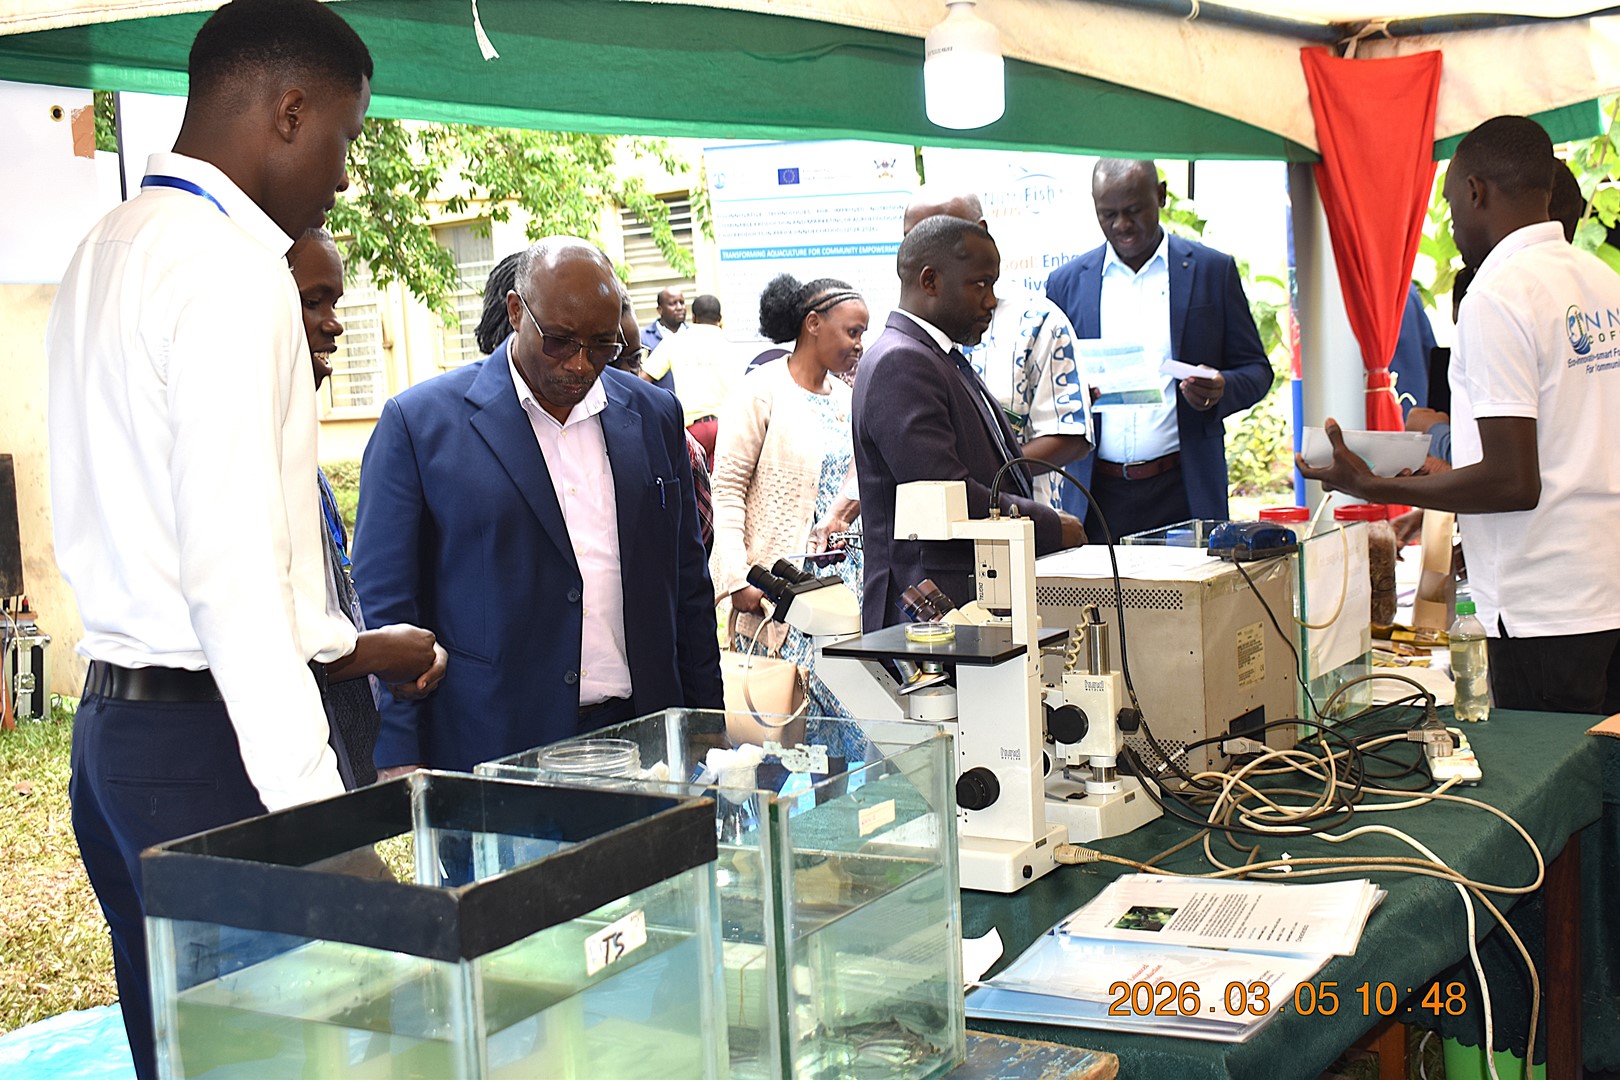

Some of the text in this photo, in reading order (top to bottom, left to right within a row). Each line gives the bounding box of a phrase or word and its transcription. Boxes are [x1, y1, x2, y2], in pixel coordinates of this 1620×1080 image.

[722, 249, 766, 260] TRANSFORMING
[767, 247, 808, 258] AQUACULTURE
[808, 246, 821, 257] FOR
[821, 245, 858, 256] COMMUNITY
